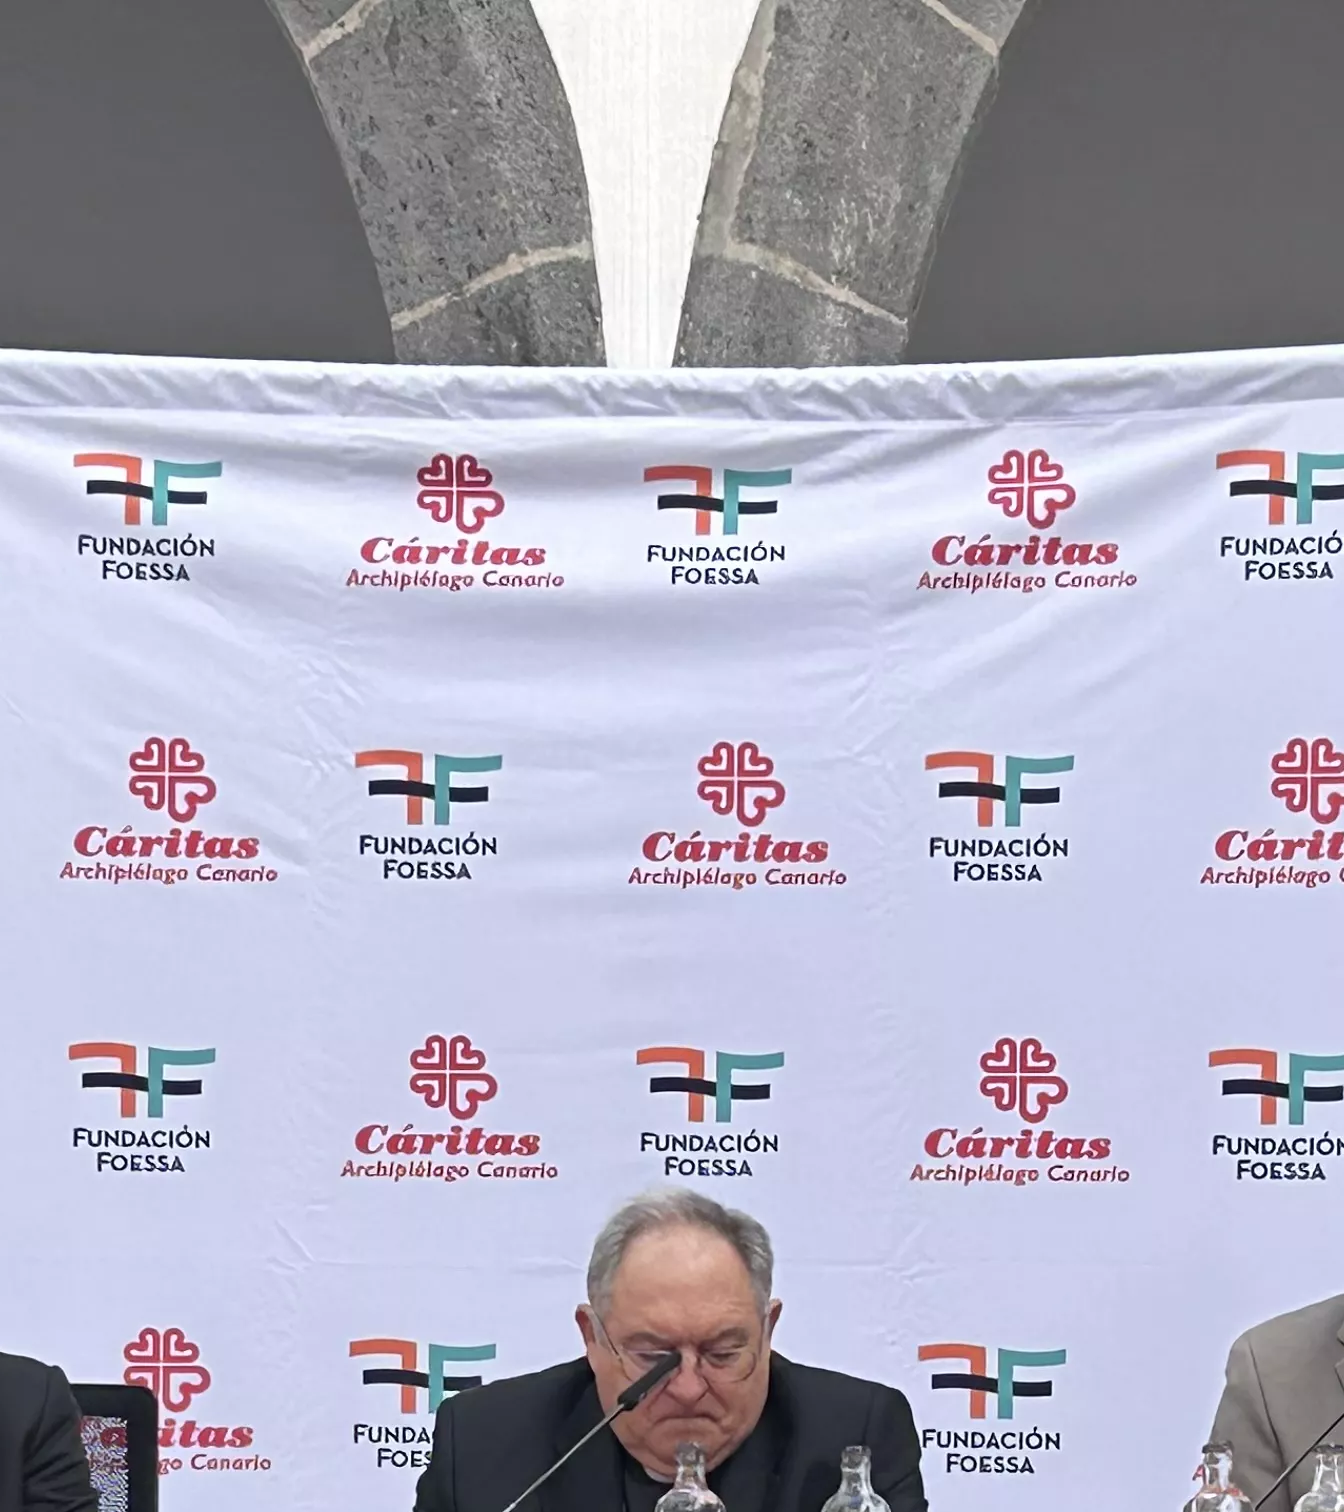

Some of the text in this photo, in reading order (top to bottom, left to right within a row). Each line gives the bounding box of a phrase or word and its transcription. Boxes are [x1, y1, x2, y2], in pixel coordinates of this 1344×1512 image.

[78, 533, 215, 557] FUNDACIÓN
[360, 537, 546, 566] Cáritas
[647, 540, 785, 562] FUNDACIÓN
[932, 534, 1119, 567] Cáritas
[102, 560, 191, 581] FOESSA
[345, 568, 564, 592] Archipiélago Canario
[672, 566, 760, 585] FOESSA
[1245, 560, 1334, 581] FOESSA
[916, 570, 1137, 594] Archipiélago Canario
[74, 825, 260, 859] Cáritas
[360, 831, 497, 856] FUNDACIÓN
[642, 831, 828, 863] Cáritas
[930, 832, 1068, 858] FUNDACIÓN
[60, 862, 278, 885] Archipiélago Canario
[384, 858, 472, 880] FOESSA
[628, 867, 847, 890] Archipiélago Canario
[954, 861, 1042, 882] FOESSA
[1200, 866, 1331, 888] Archipiélago
[73, 1124, 210, 1149] FUNDACIÓN
[355, 1124, 540, 1156] Cáritas
[640, 1128, 778, 1153] FUNDACIÓN
[924, 1127, 1111, 1160] Cáritas
[97, 1152, 185, 1172] FOESSA
[340, 1160, 558, 1182] Archipiélago Canario
[664, 1156, 753, 1176] FOESSA
[1237, 1159, 1326, 1180] FOESSA
[910, 1164, 1130, 1186] Archipiélago Canario
[354, 1423, 432, 1444] FUNDA
[922, 1426, 1060, 1450] FUNDACIÓN
[191, 1453, 272, 1471] Canario
[377, 1447, 432, 1468] FOES
[946, 1453, 1035, 1474] FOESSA
